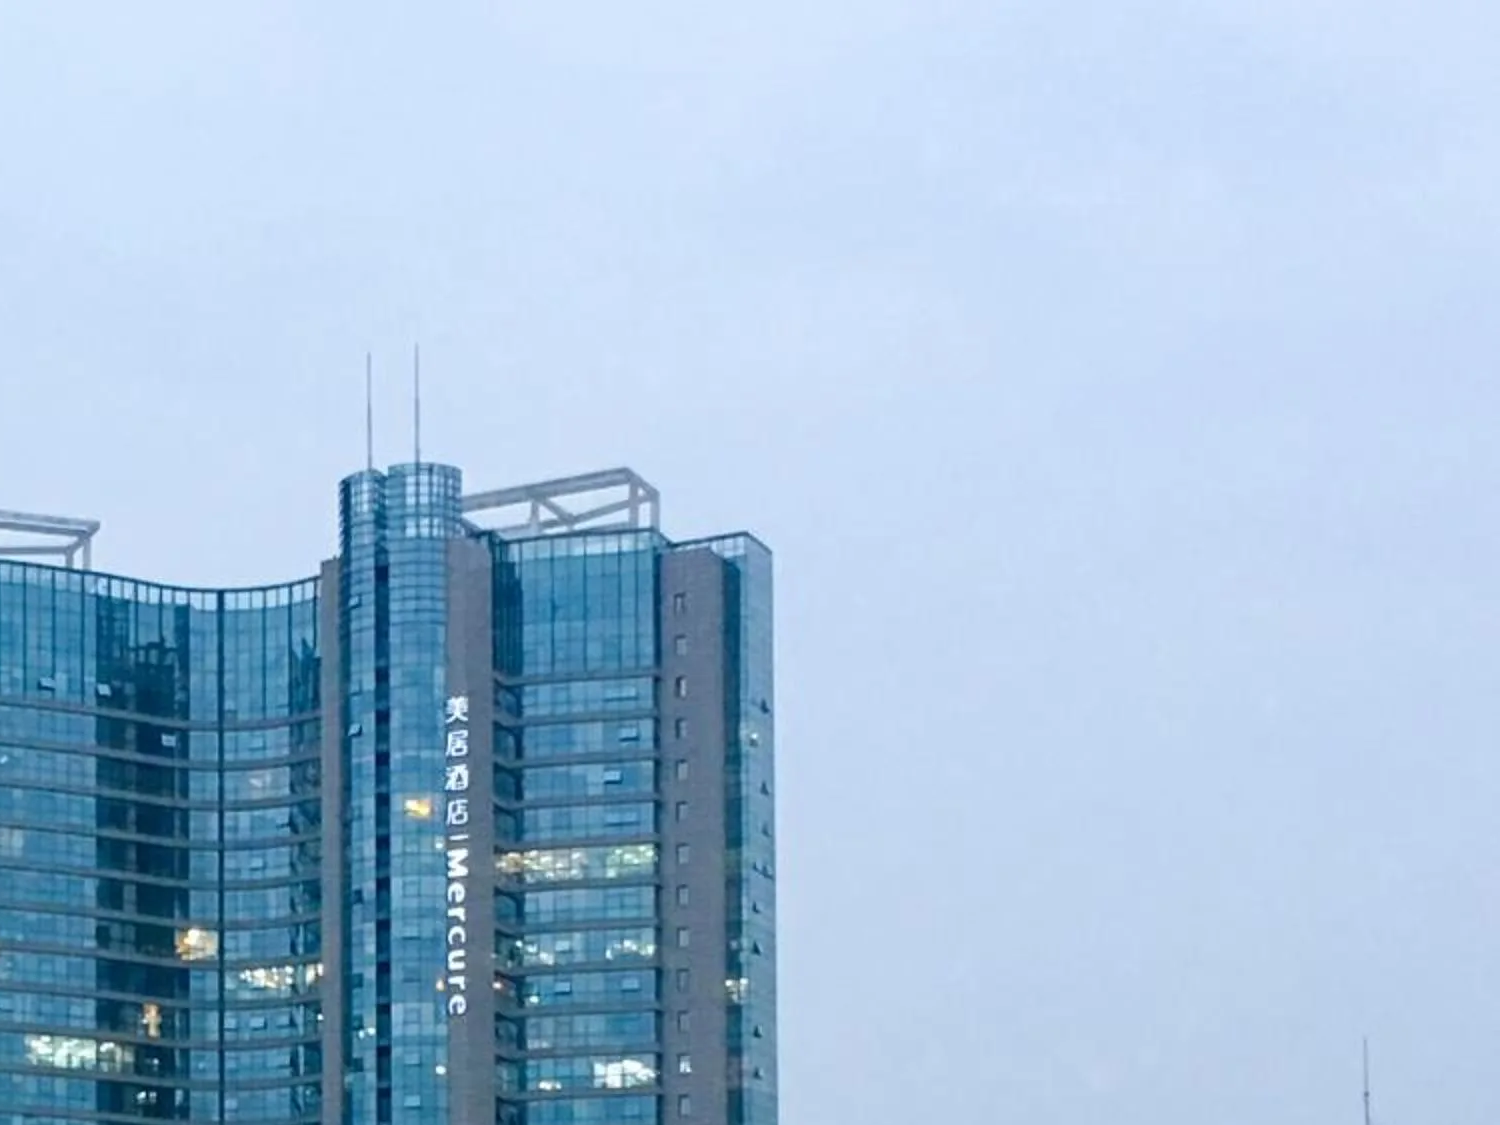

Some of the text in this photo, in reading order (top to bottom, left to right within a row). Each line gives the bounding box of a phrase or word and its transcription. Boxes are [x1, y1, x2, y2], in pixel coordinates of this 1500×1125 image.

[445, 696, 469, 1015] 美居酒店 Mercure
